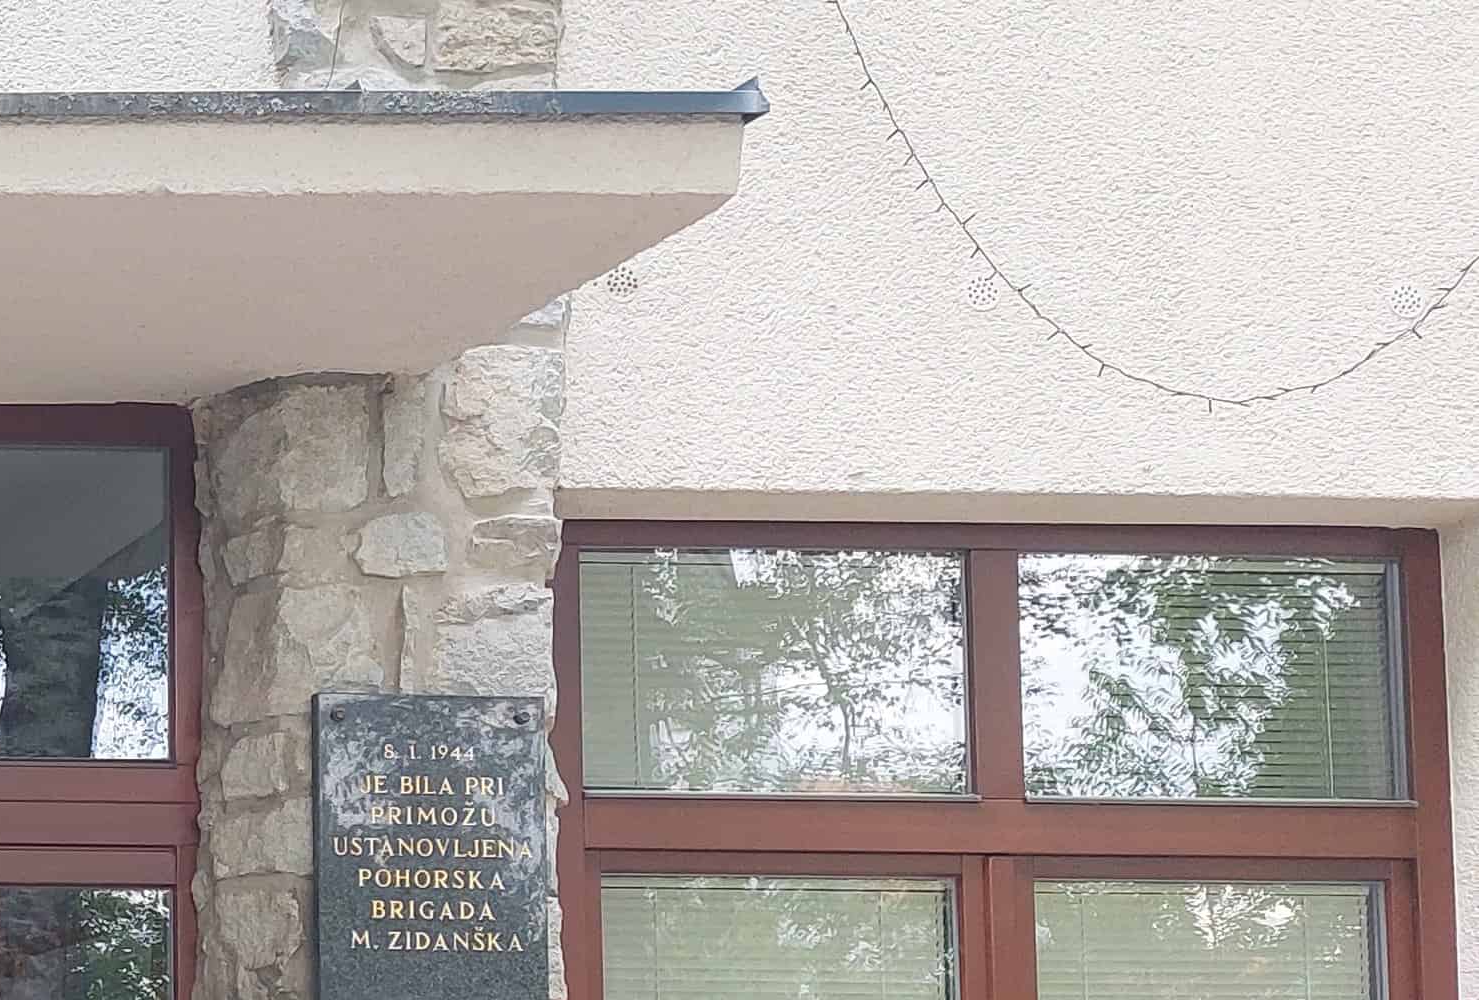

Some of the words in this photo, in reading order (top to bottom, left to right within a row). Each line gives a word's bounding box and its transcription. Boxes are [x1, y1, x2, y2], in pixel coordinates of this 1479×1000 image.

[430, 744, 475, 761] 1944
[360, 776, 388, 795] JE
[400, 776, 454, 795] BILA
[465, 777, 505, 795] PRI
[371, 802, 497, 826] PRIMOŽU
[333, 837, 533, 859] USTANOVLJENA
[358, 869, 506, 890] POHORSKA
[371, 900, 496, 921] BRIGADA
[351, 930, 380, 950] M.
[388, 926, 524, 952] ZIDANŠKA
